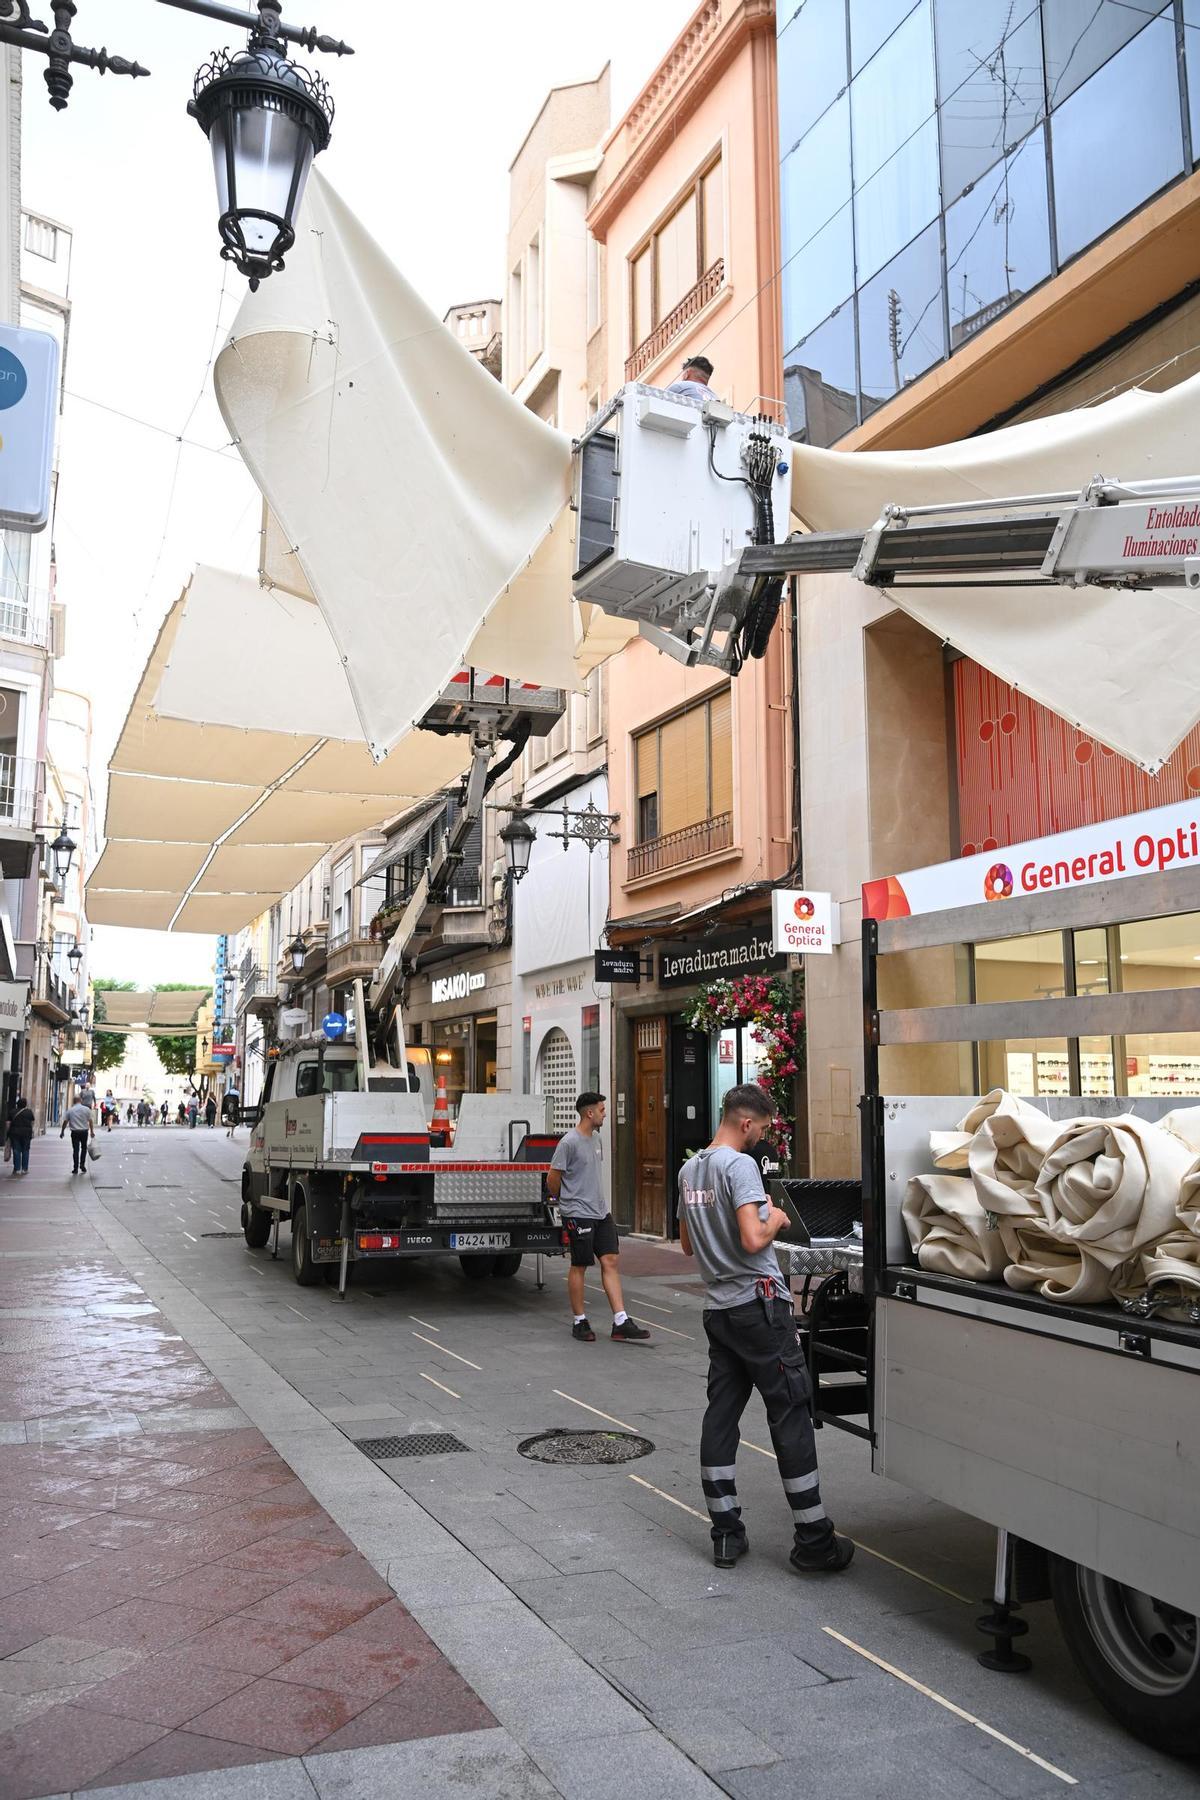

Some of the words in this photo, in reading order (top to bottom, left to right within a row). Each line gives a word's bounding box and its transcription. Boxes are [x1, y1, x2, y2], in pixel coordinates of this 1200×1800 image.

[1122, 534, 1198, 558] Iluminaciones
[1020, 840, 1126, 892] General
[1133, 821, 1199, 871] Opti
[784, 923, 825, 935] General
[788, 935, 822, 948] Optica
[602, 960, 634, 968] levadura
[431, 973, 466, 1004] MISAKO
[407, 1236, 433, 1244] IVECO
[458, 1235, 485, 1246] 8424
[488, 1235, 509, 1246] MTK
[527, 1233, 551, 1241] DAILY
